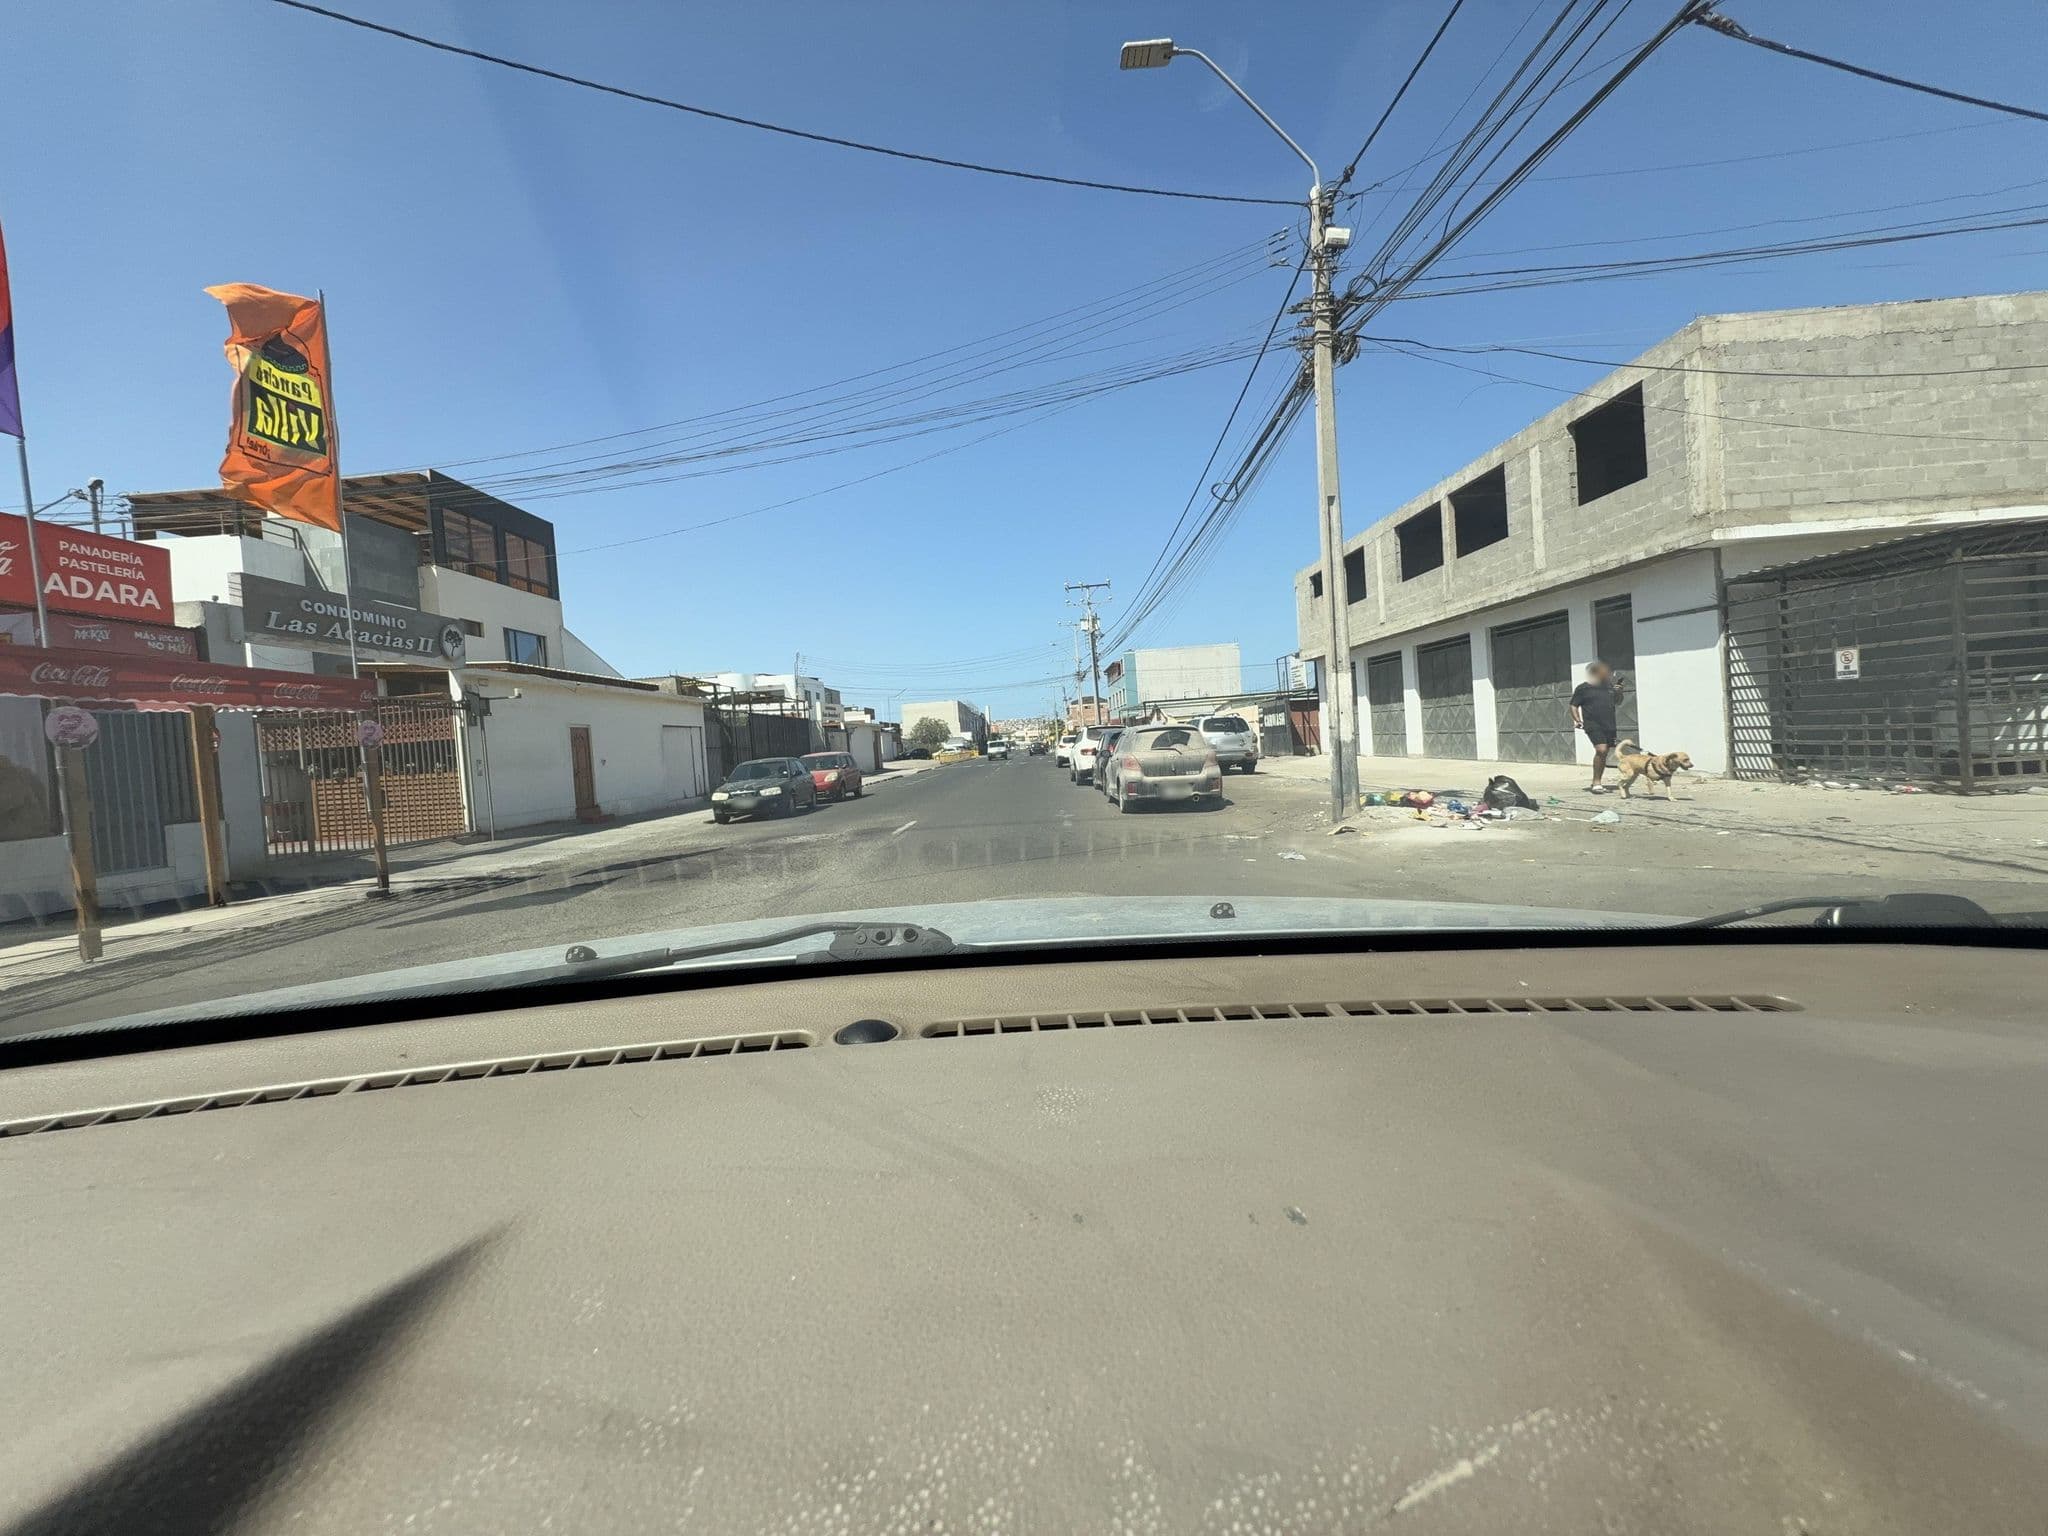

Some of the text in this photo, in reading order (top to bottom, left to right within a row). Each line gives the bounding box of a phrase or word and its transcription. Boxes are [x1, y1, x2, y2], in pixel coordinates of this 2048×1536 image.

[59, 541, 144, 566] PANADERÍA
[59, 557, 146, 581] PASTELERÍA
[43, 572, 162, 610] ADARA
[300, 600, 407, 629] CONDOMINIO
[265, 610, 434, 653] Las Acacias II
